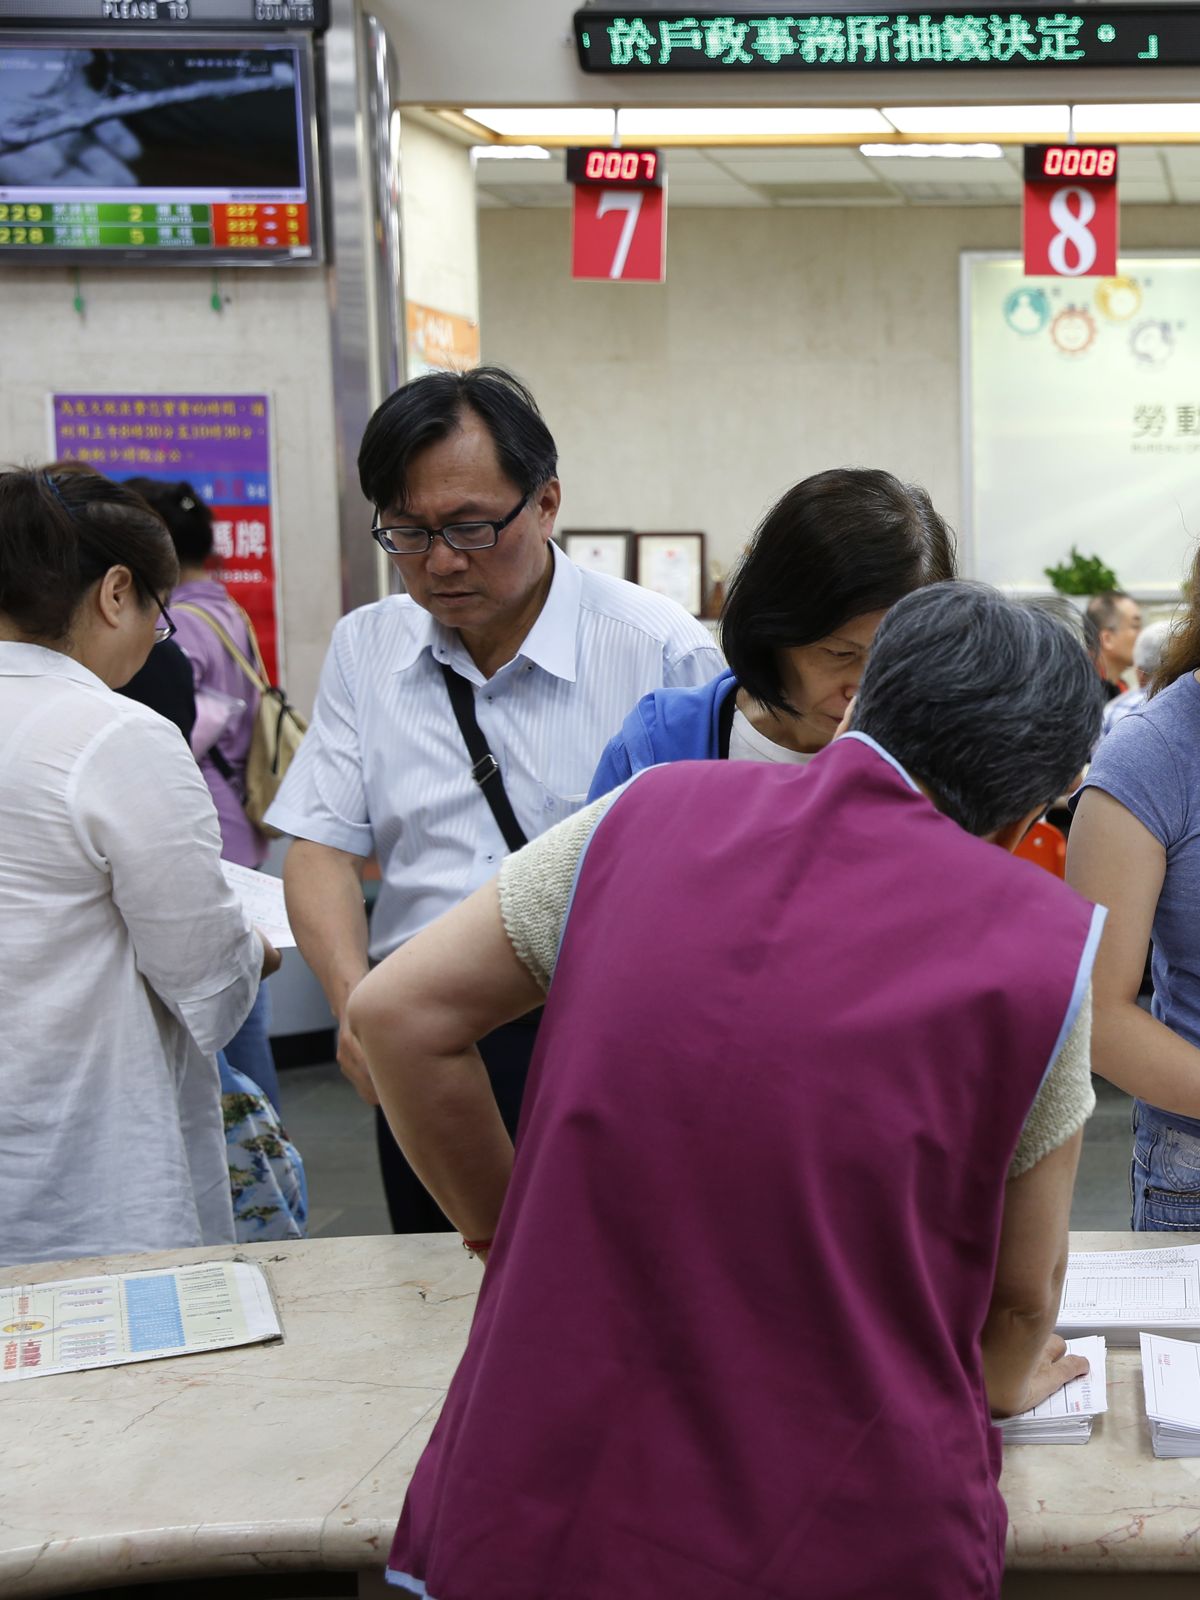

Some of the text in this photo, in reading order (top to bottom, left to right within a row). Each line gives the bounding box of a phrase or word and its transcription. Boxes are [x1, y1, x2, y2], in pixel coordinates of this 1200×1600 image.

[102, 3, 189, 20] PLEASE TO
[255, 5, 315, 21] COUNTER
[586, 152, 657, 180] 0007
[1044, 148, 1117, 177] 0008
[596, 191, 644, 280] 7
[1048, 186, 1097, 277] 8
